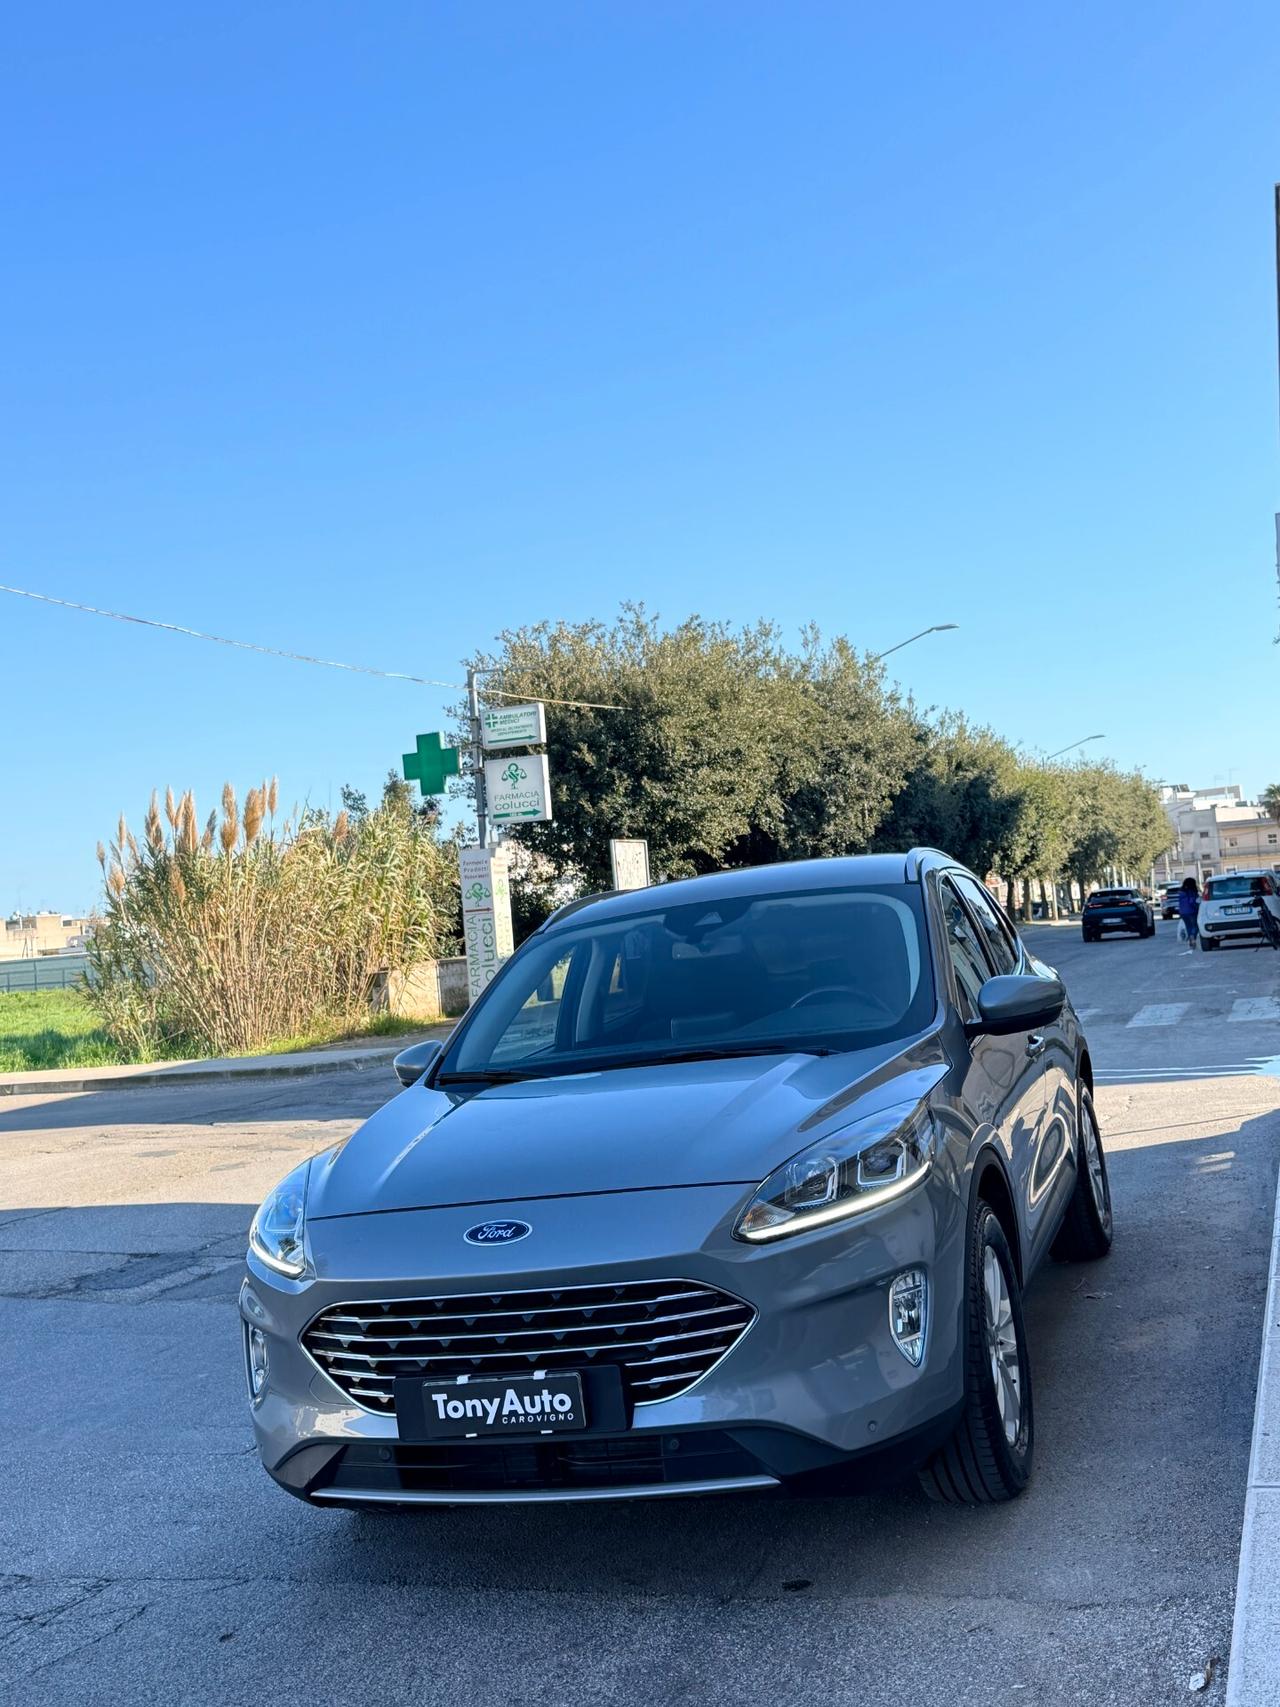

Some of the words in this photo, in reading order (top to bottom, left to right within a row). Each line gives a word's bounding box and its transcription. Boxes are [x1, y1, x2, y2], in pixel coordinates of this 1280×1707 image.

[499, 711, 537, 720] AMBULATORI
[494, 790, 540, 801] FARMACIA
[494, 800, 540, 811] colucci
[467, 913, 481, 998] FARMACIA
[477, 1224, 516, 1240] Ford
[502, 1412, 574, 1424] CAROVIGNO
